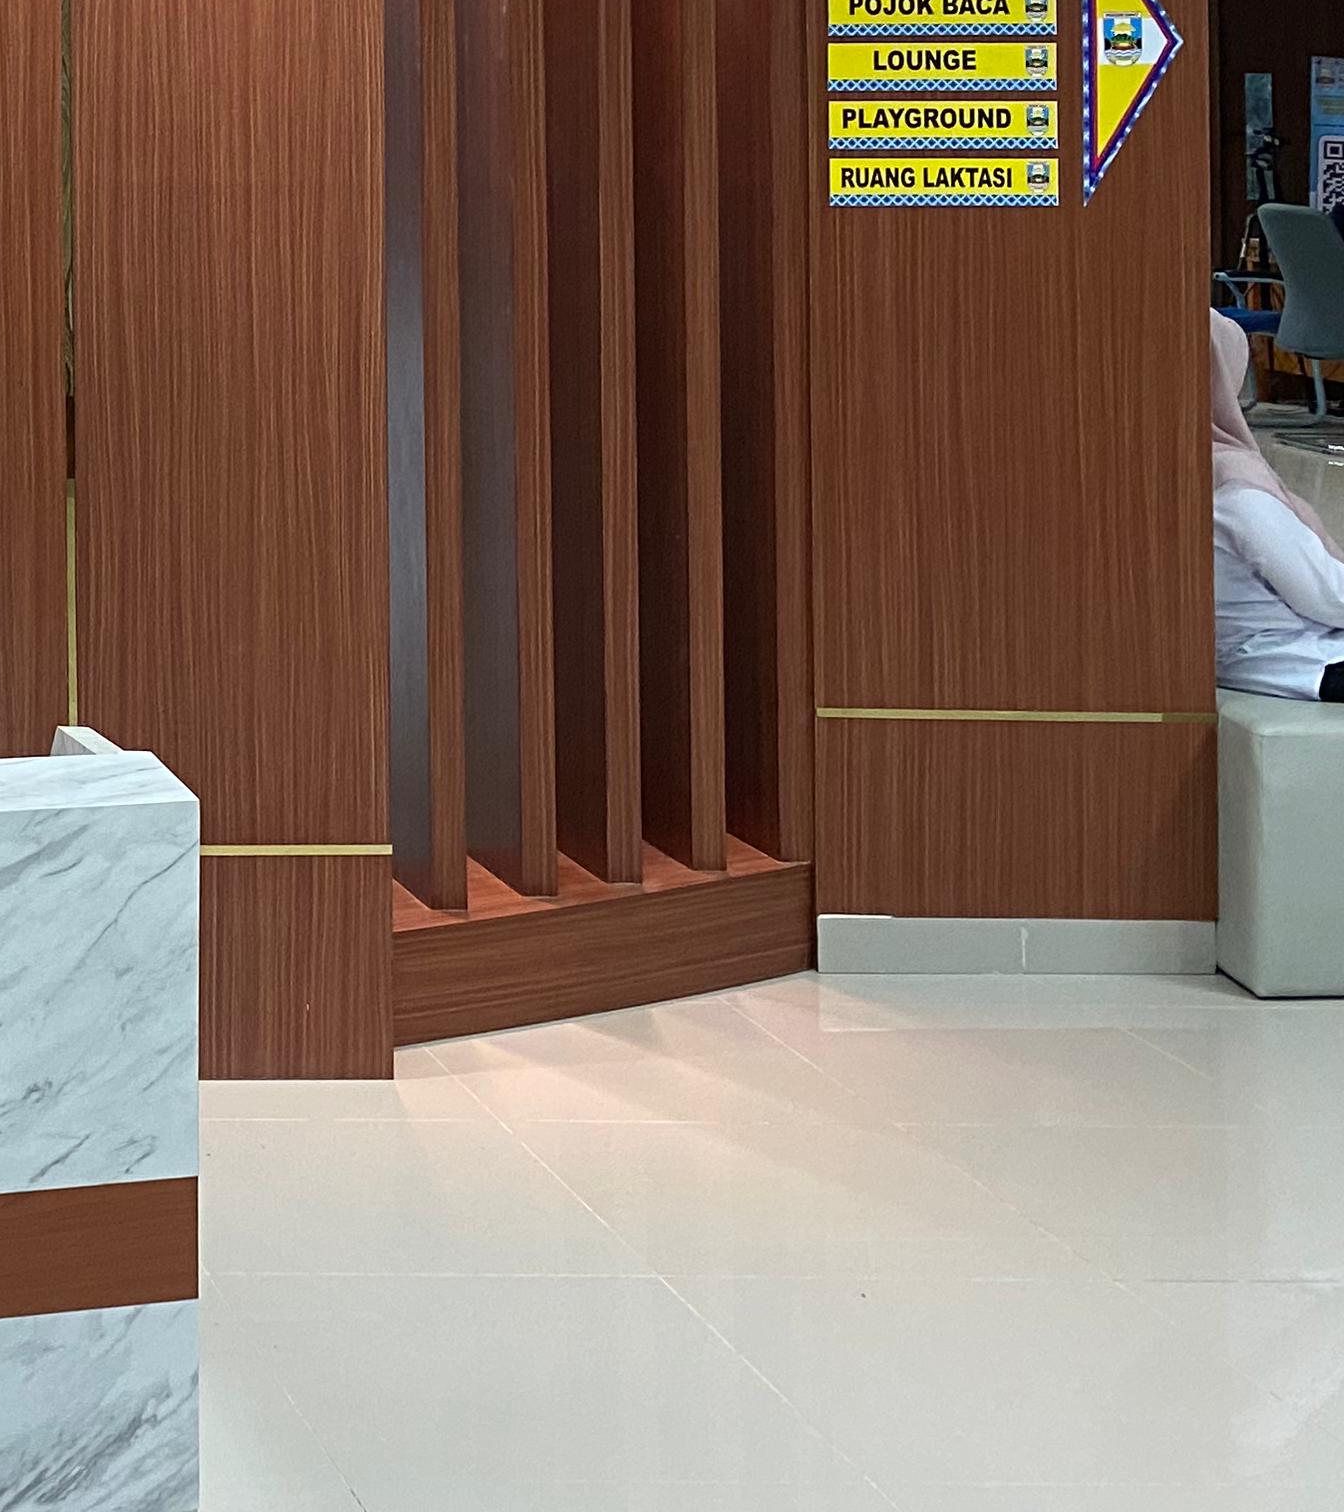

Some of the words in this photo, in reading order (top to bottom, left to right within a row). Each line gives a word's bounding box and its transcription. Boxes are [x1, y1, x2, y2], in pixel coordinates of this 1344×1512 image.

[874, 50, 976, 70] LOUNGE
[843, 108, 1011, 128] PLAYGROUND
[842, 168, 914, 187] RUANG
[924, 168, 1011, 187] LAKTASI
